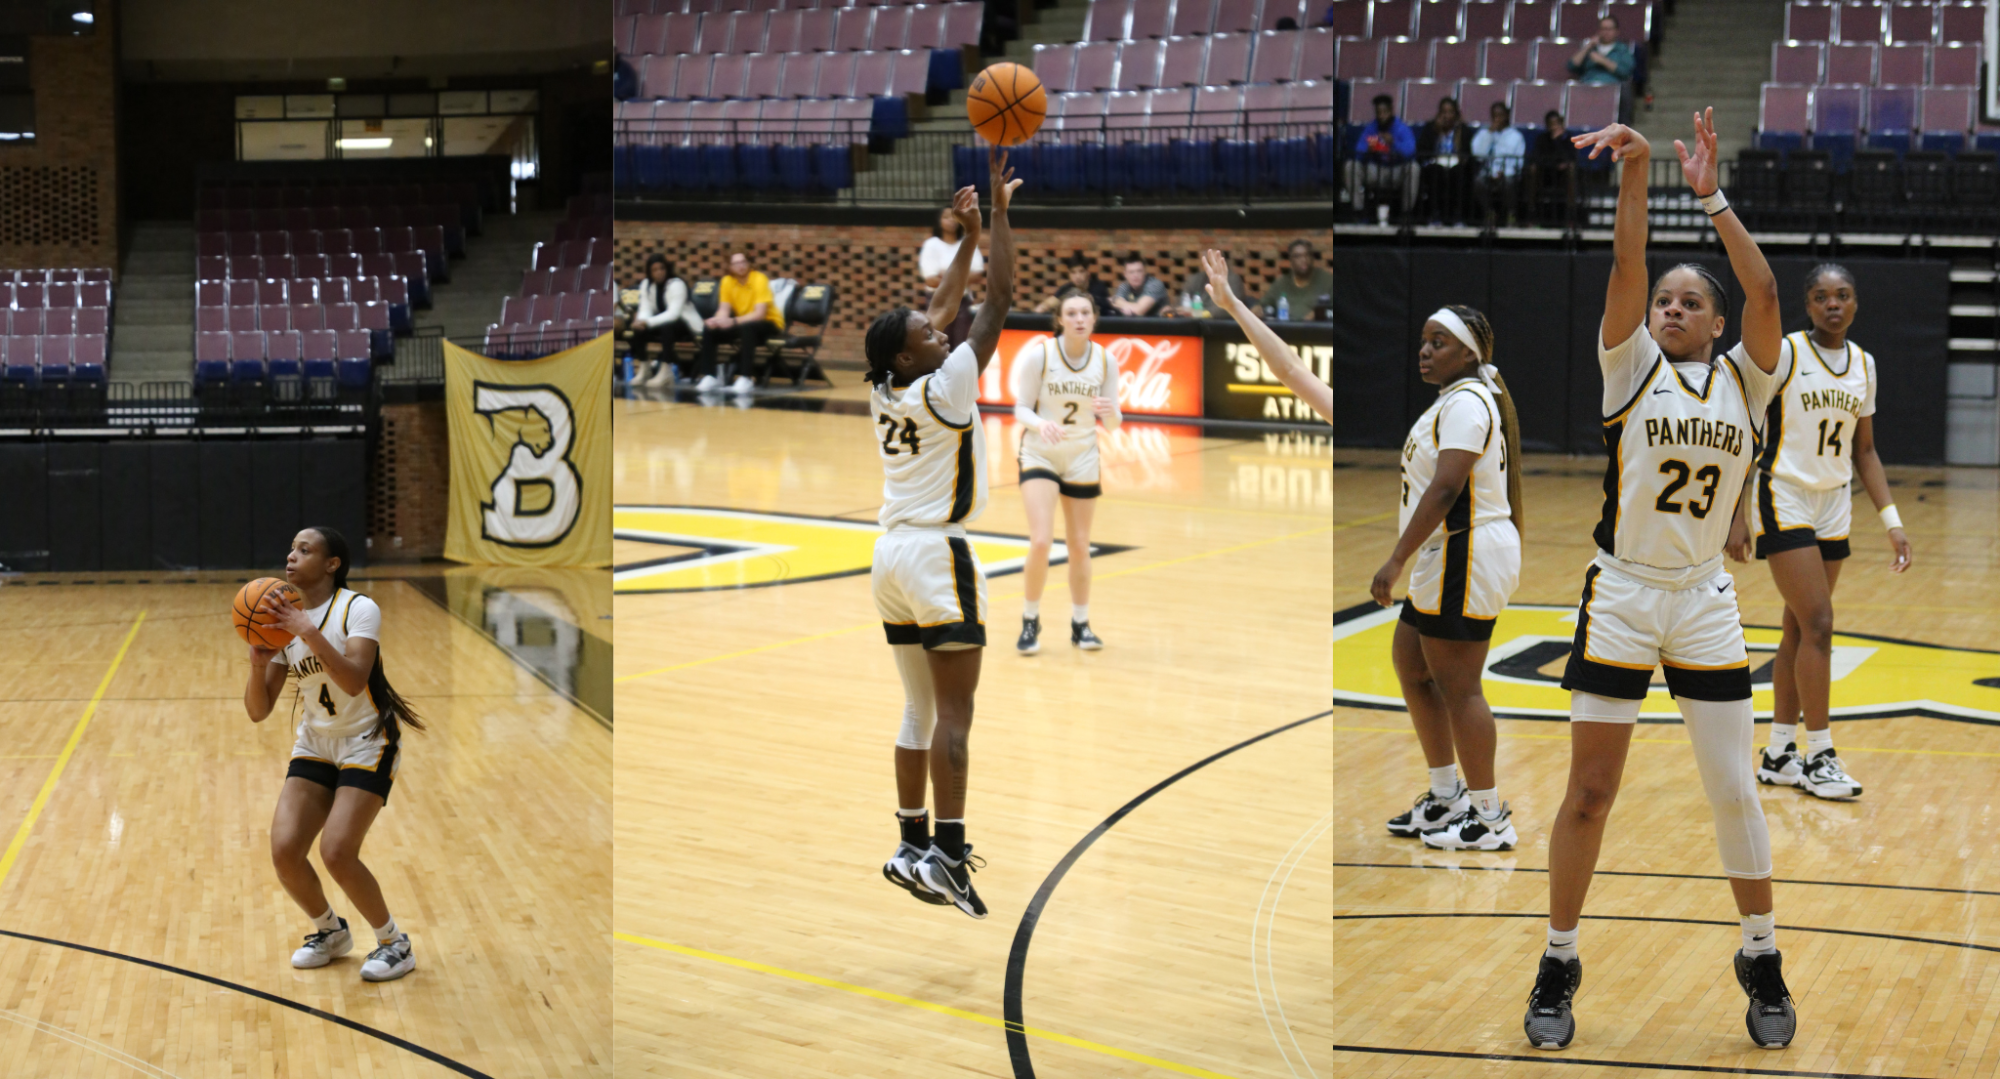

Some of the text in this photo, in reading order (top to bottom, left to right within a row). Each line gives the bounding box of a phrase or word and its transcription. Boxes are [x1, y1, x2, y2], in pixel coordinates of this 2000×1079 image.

[1063, 401, 1079, 425] 2
[878, 412, 921, 455] 24
[1645, 417, 1744, 457] PANTHERS
[1817, 418, 1844, 457] 14
[1654, 458, 1722, 520] 23
[318, 683, 337, 716] 4
